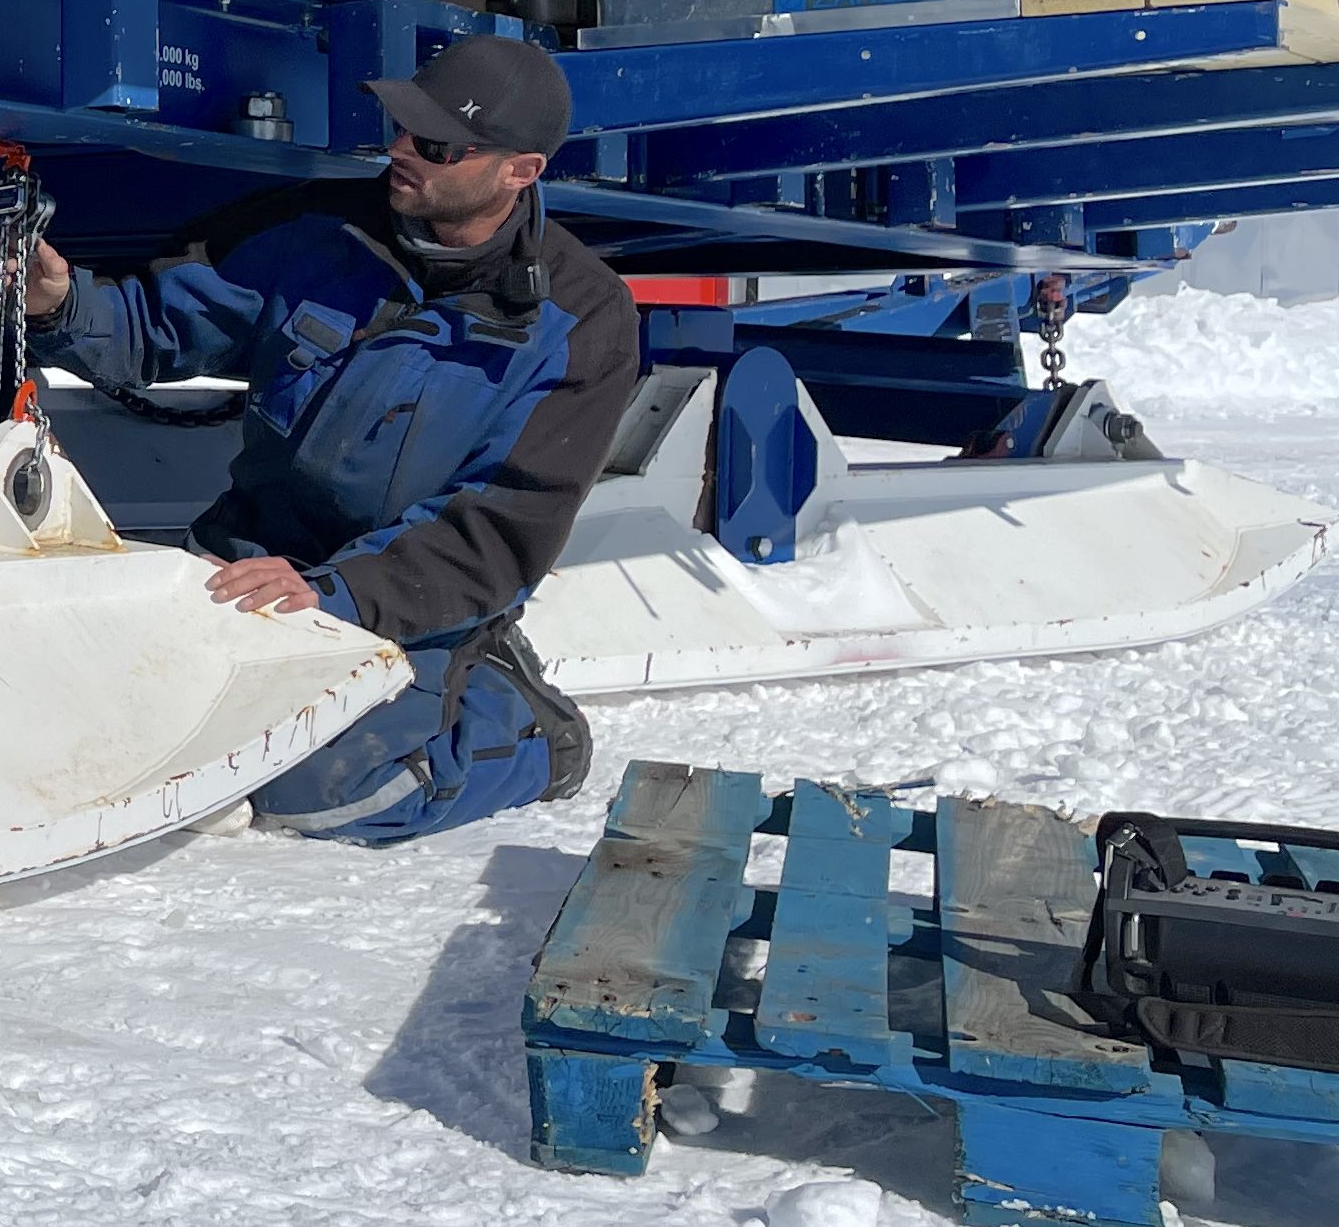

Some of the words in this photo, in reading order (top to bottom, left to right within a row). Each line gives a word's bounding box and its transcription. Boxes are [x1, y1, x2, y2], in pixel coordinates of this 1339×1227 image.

[159, 45, 183, 64] .000
[185, 48, 199, 71] kg
[159, 68, 183, 88] ,000
[185, 72, 206, 91] lbs.
